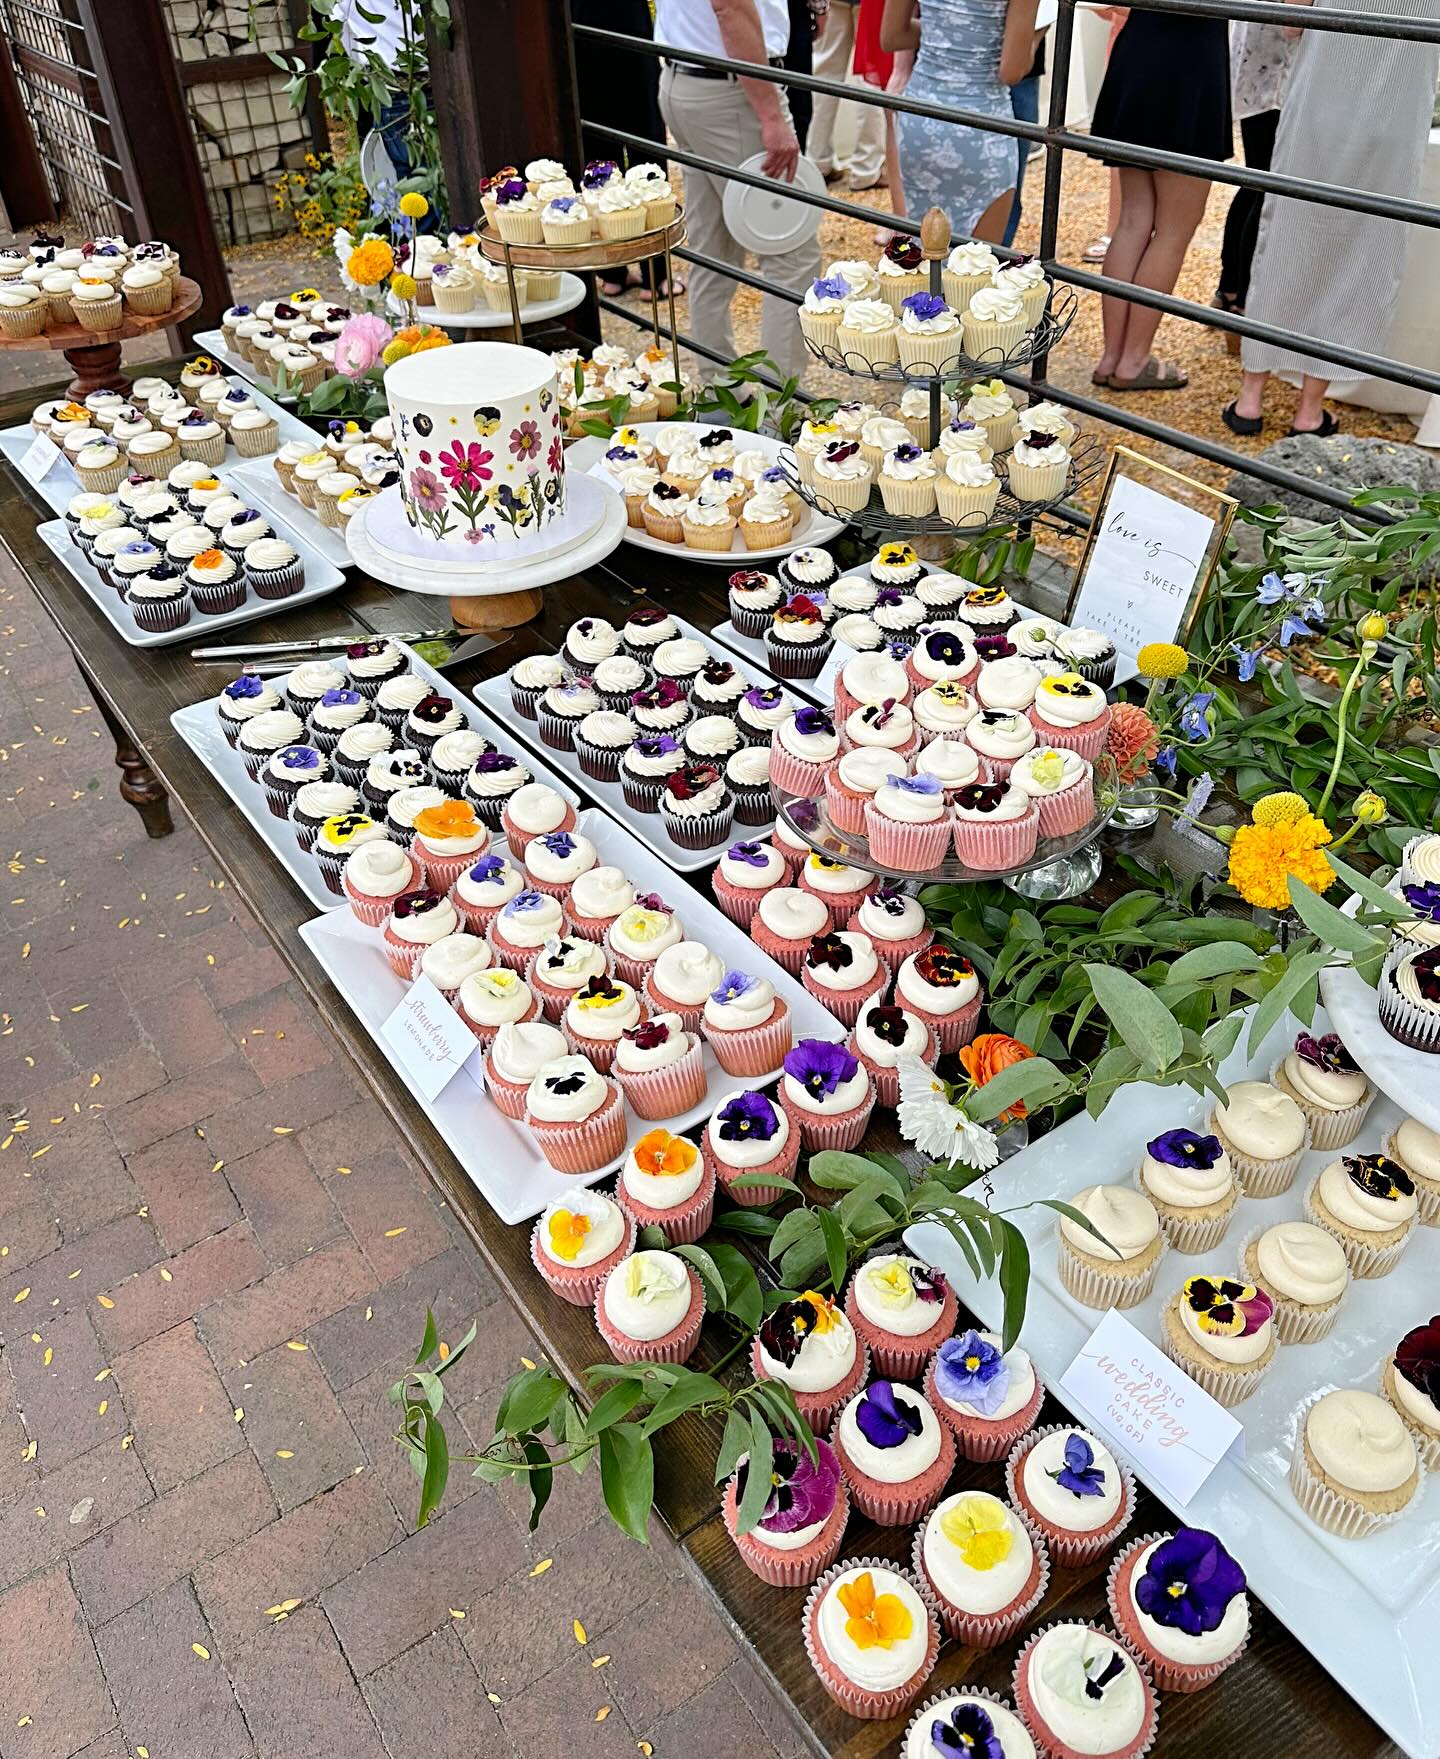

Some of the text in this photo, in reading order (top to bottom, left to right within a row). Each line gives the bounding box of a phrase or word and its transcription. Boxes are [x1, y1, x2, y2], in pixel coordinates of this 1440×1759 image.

[1107, 512, 1196, 569] love is
[1143, 570, 1184, 598] SWEET
[1107, 611, 1141, 636] PLEASE
[403, 1019, 435, 1062] LEMONADE
[404, 999, 459, 1065] strawberry
[1130, 1357, 1185, 1409] CLASSIC
[1080, 1351, 1217, 1464] wedding
[1114, 1393, 1153, 1431] CAKE
